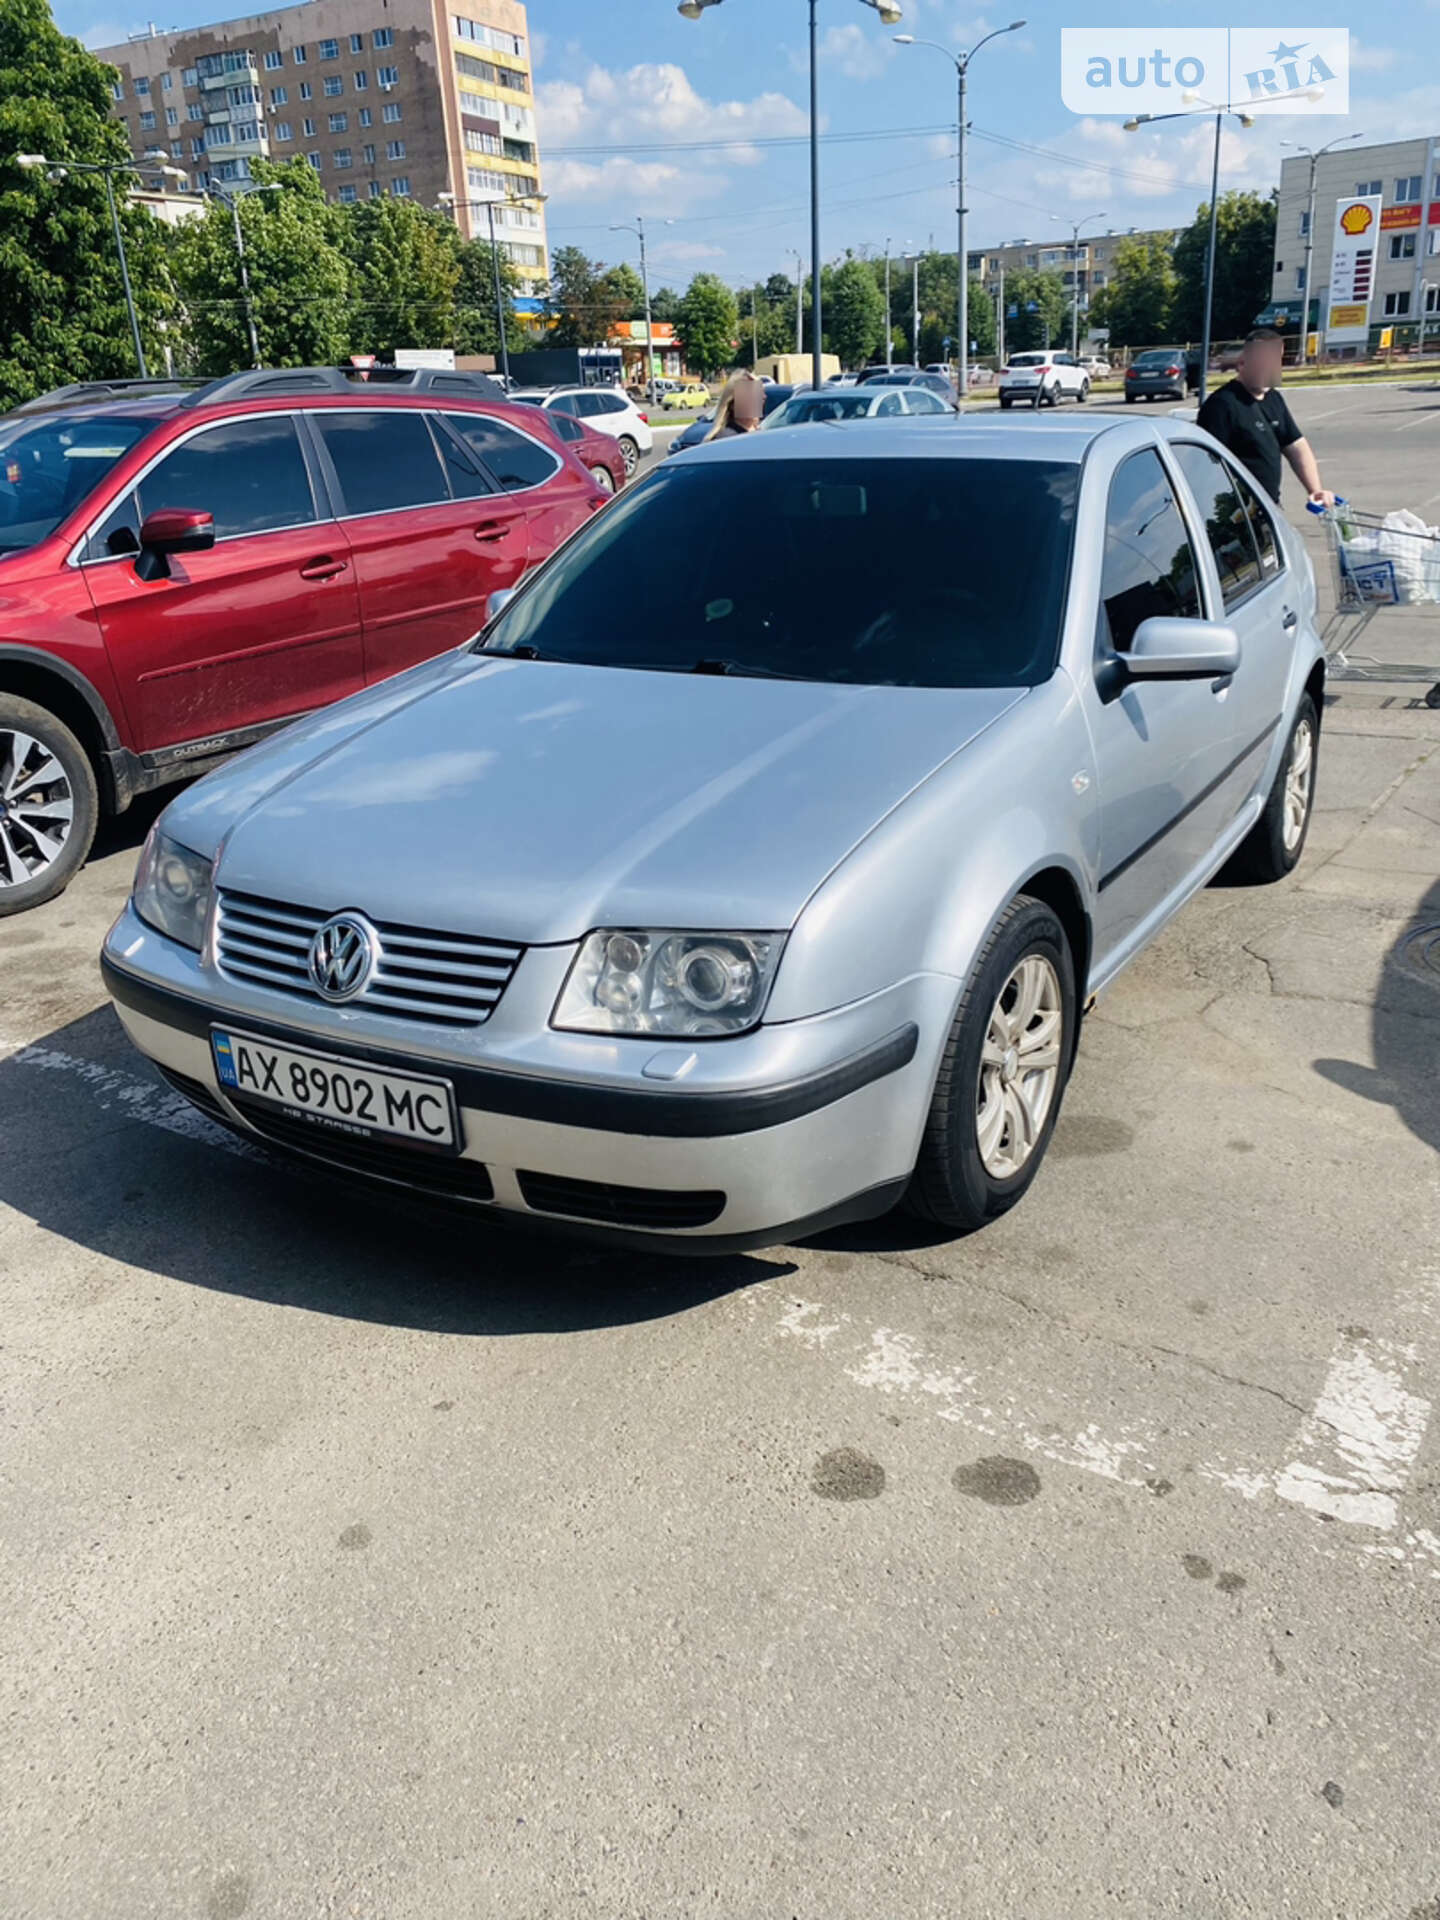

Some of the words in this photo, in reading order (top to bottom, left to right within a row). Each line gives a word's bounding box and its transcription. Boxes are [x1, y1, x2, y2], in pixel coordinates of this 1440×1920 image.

[174, 737, 230, 758] OUTBACK
[219, 1066, 235, 1081] UA
[238, 1046, 284, 1097] AX
[288, 1062, 378, 1123] 8902
[383, 1084, 445, 1136] MC
